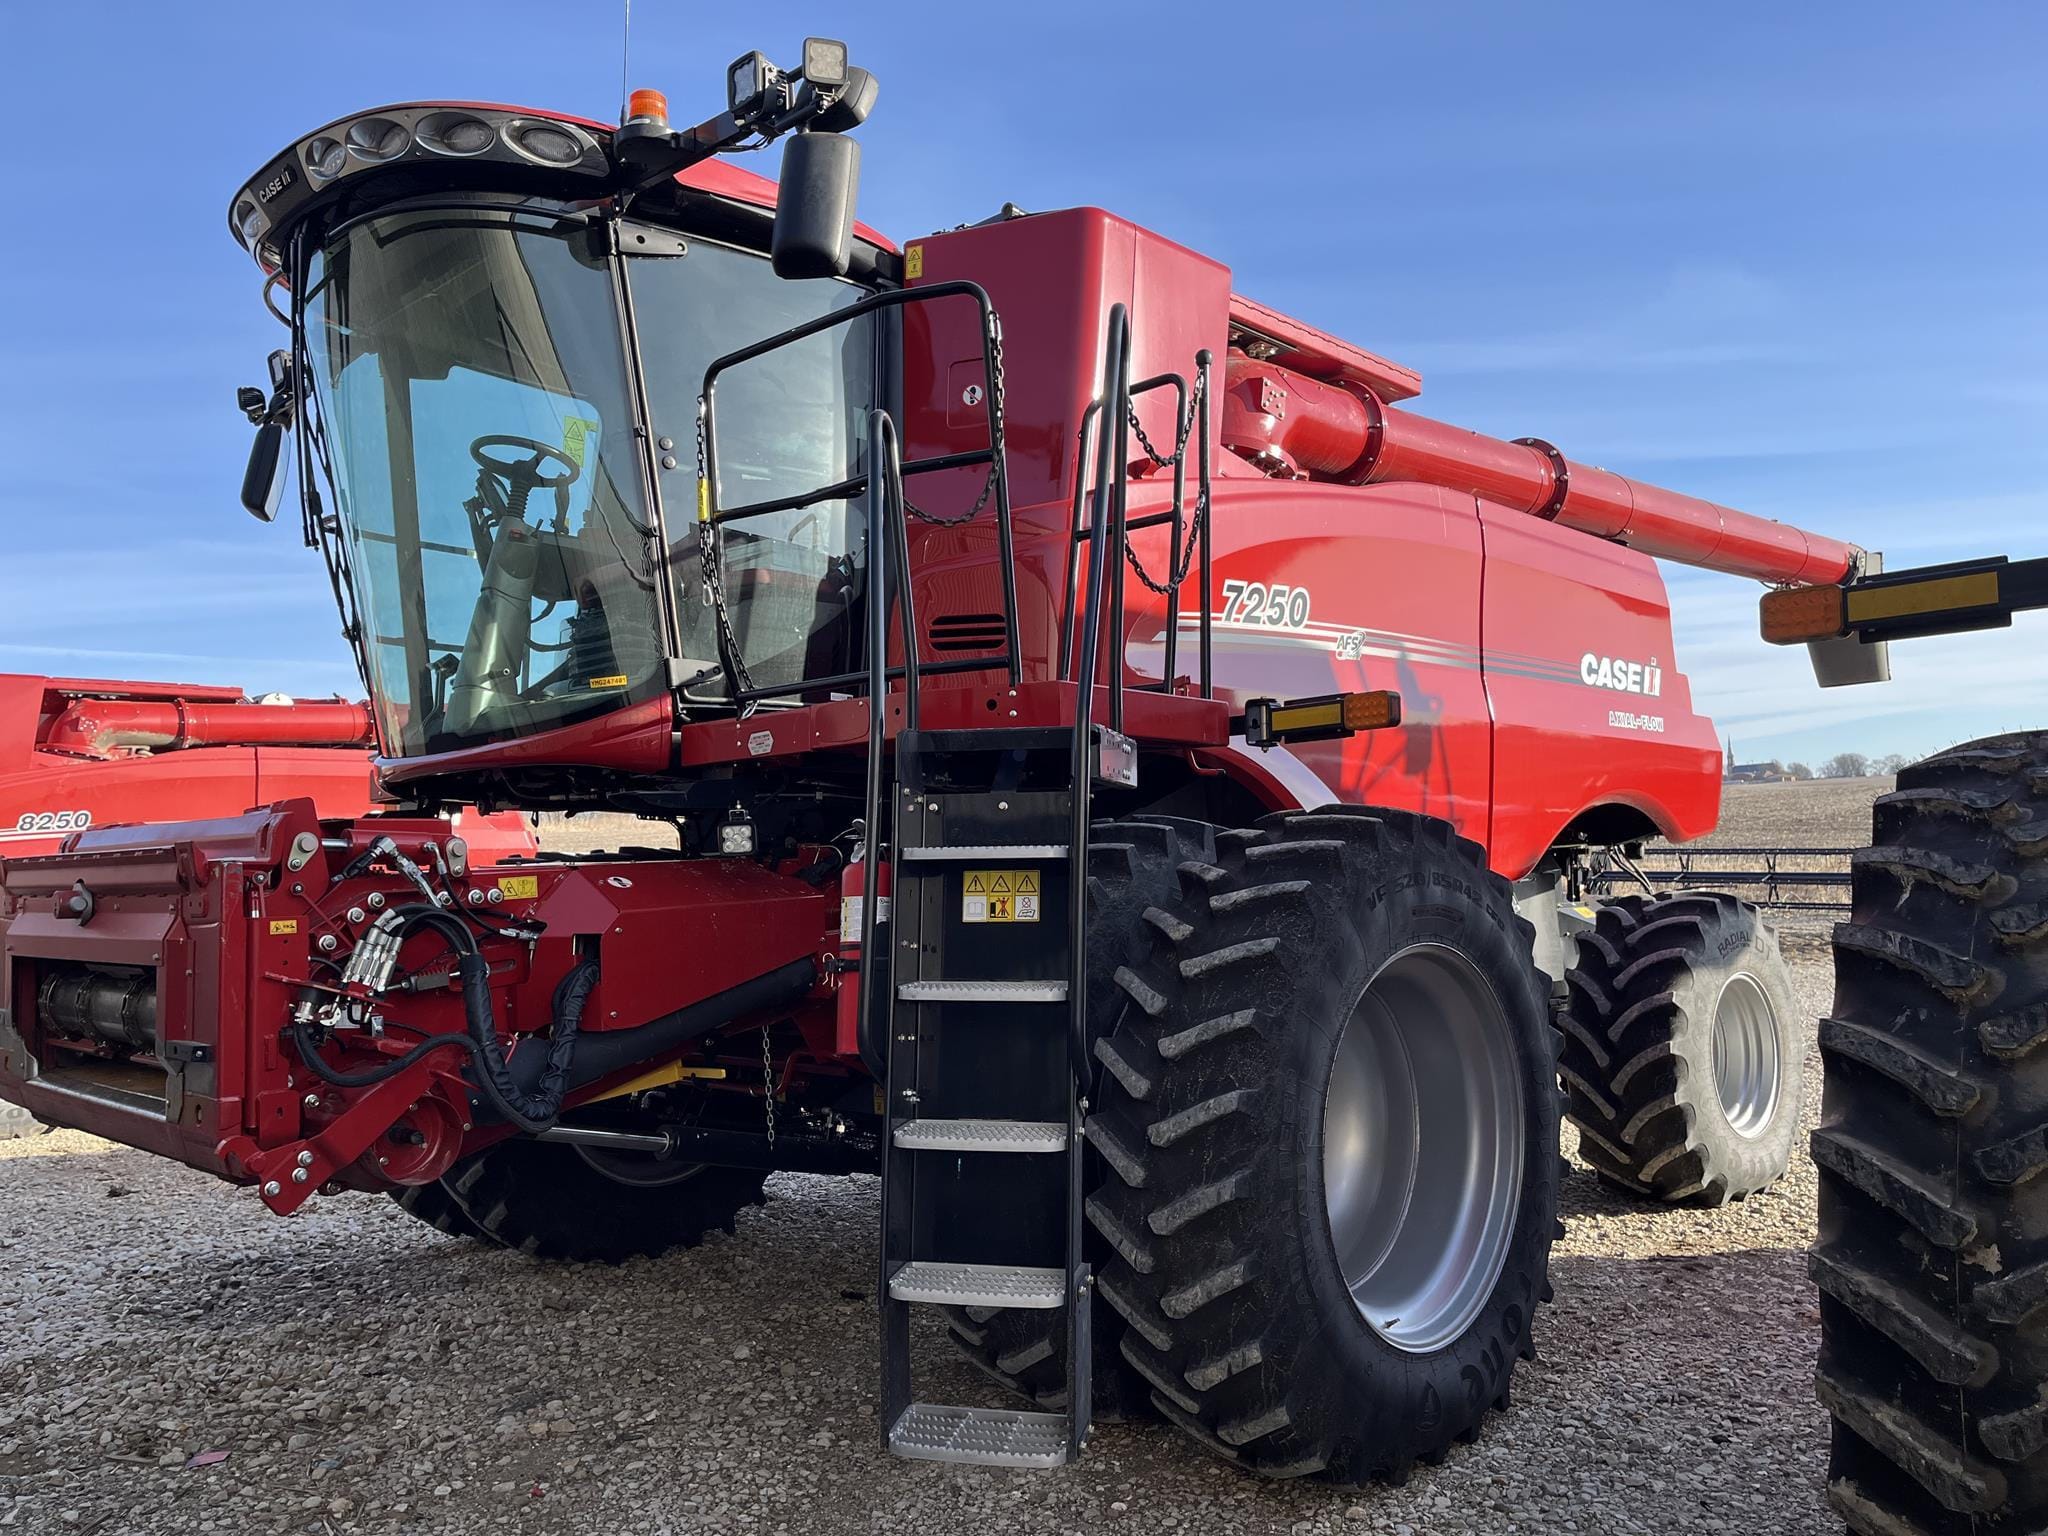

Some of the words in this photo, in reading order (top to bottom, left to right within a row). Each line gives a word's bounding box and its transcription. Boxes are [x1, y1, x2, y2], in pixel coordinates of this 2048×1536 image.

[259, 178, 283, 203] CASE
[1222, 579, 1310, 629] 7250
[1336, 634, 1360, 651] AFS
[1580, 653, 1641, 693] CASE
[1609, 711, 1664, 732] AXIAL-FLOW
[18, 810, 91, 832] 8250
[1717, 931, 1753, 956] RADIAL
